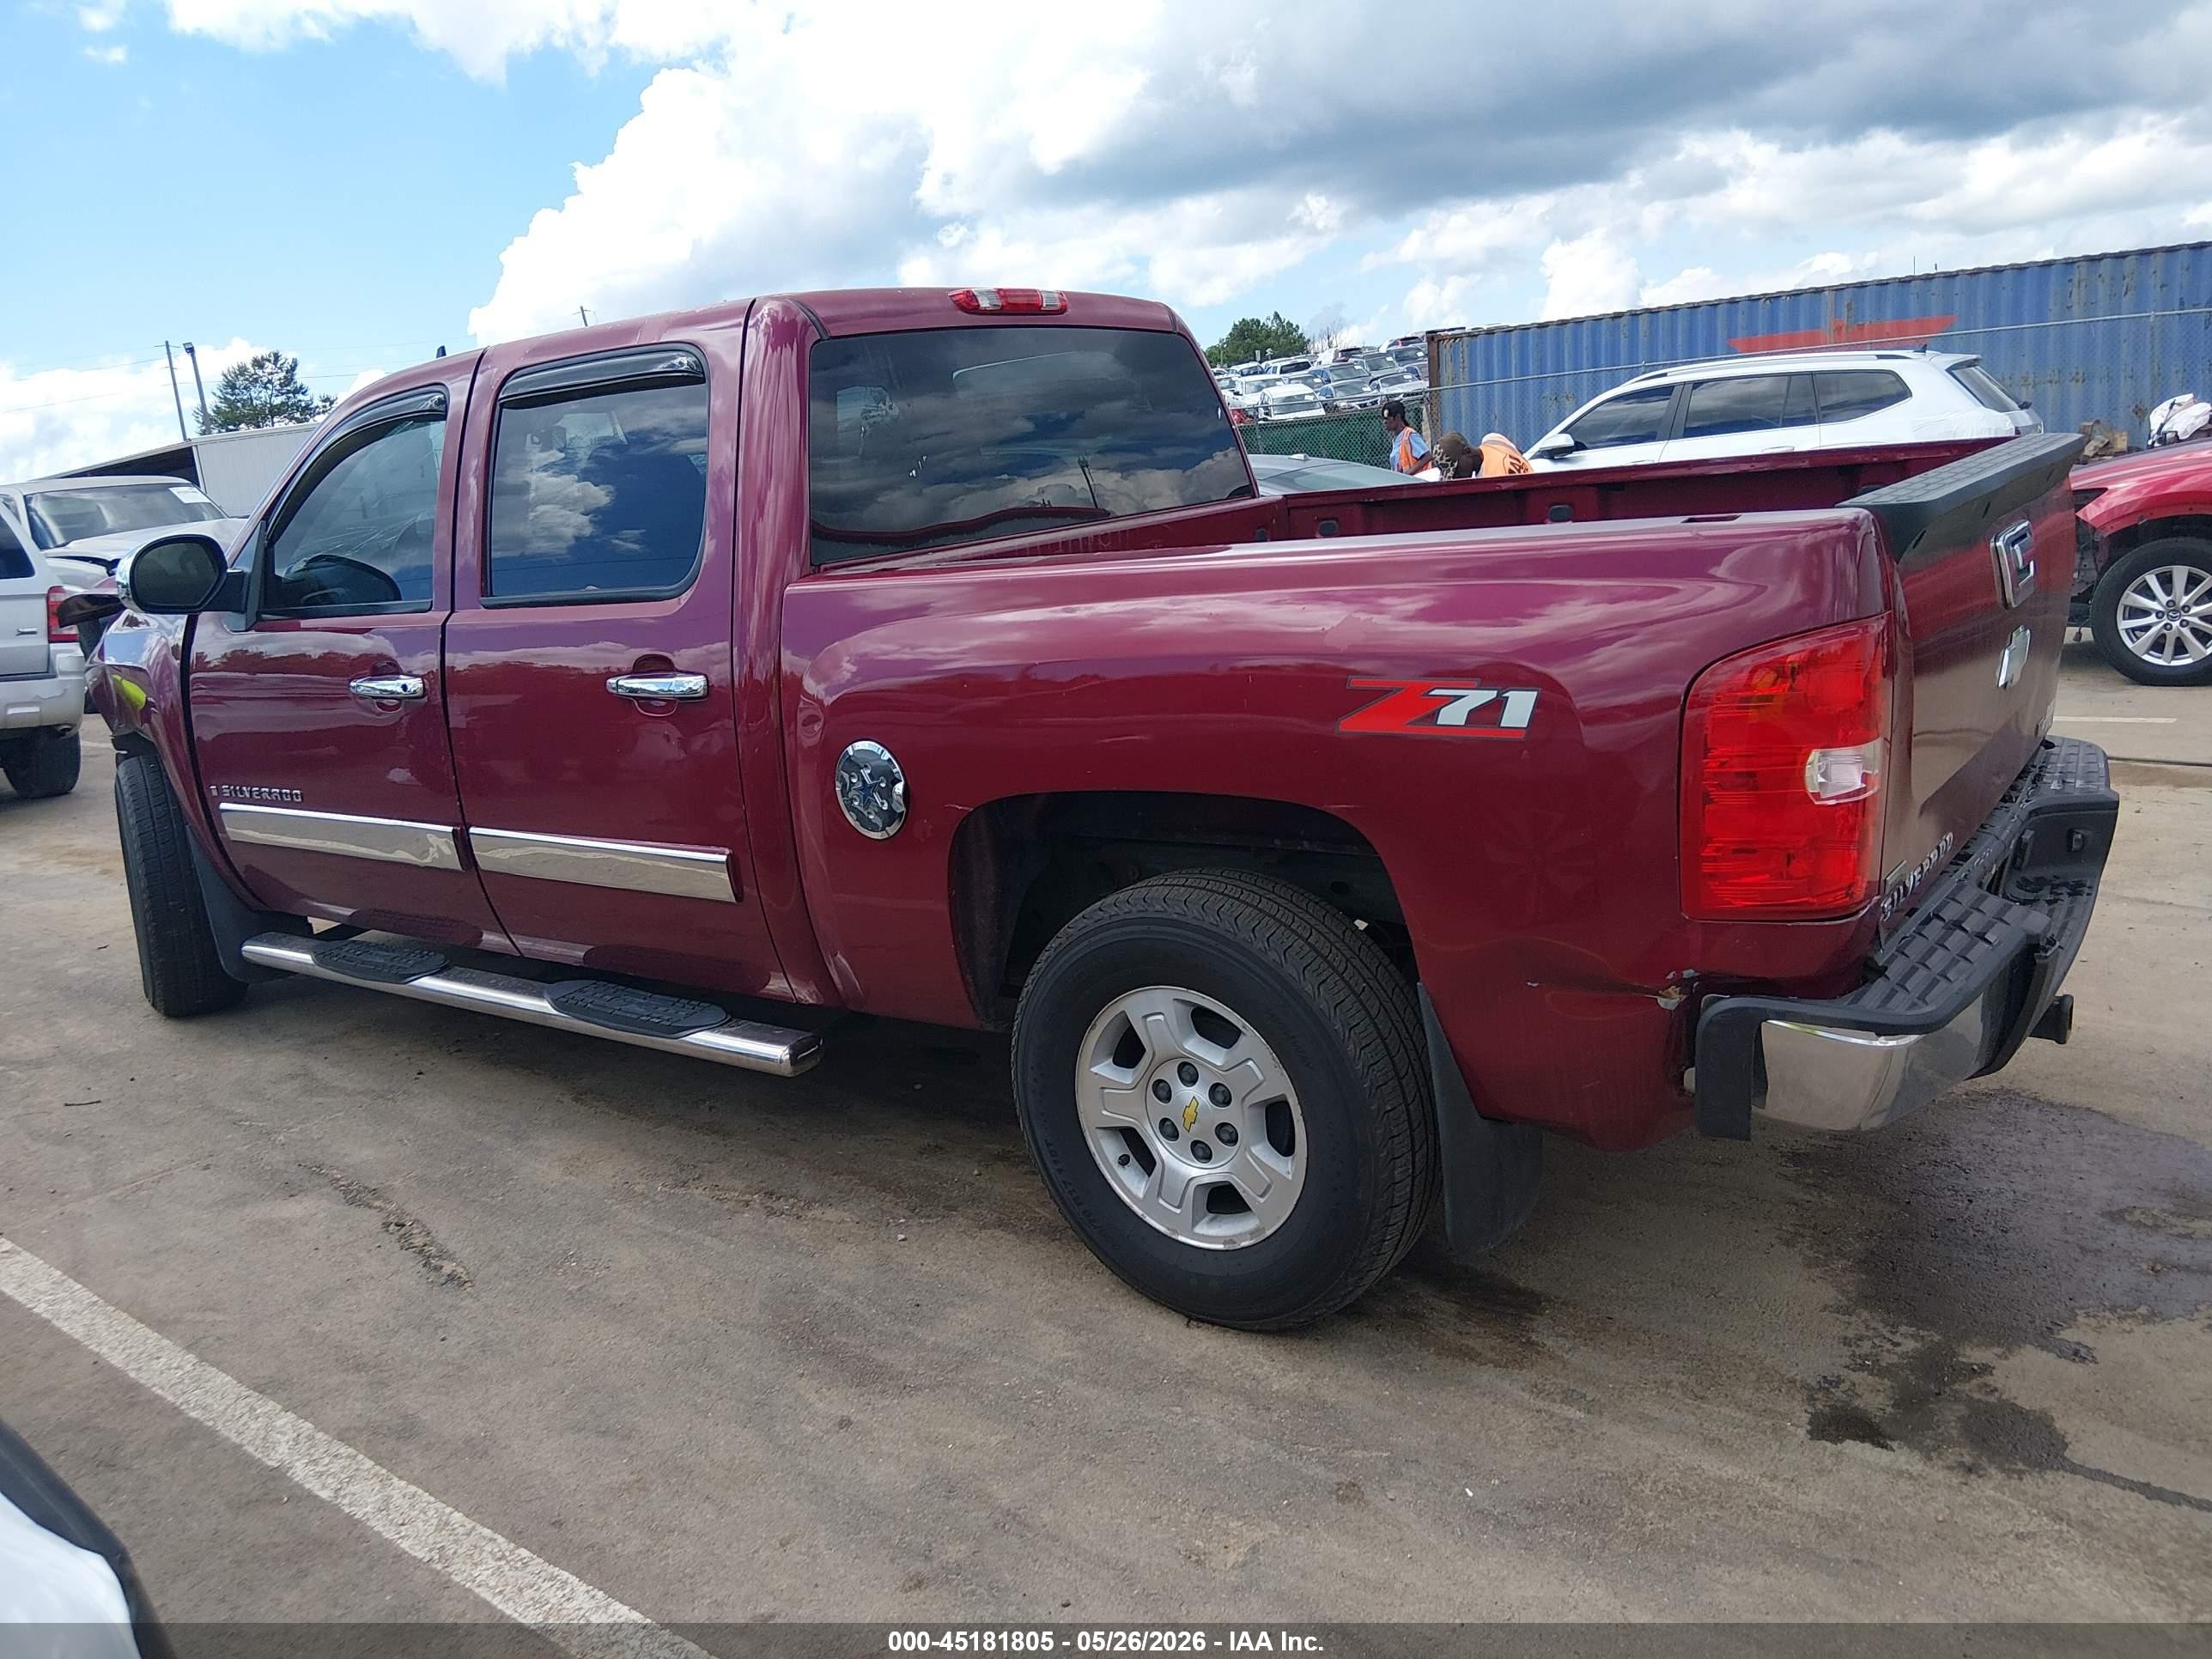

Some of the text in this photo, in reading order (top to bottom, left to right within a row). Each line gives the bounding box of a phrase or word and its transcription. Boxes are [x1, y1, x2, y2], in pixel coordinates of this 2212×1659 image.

[1336, 676, 1541, 739] Z71
[222, 785, 303, 802] SILVERADO
[1881, 831, 1954, 921] SILVERADO
